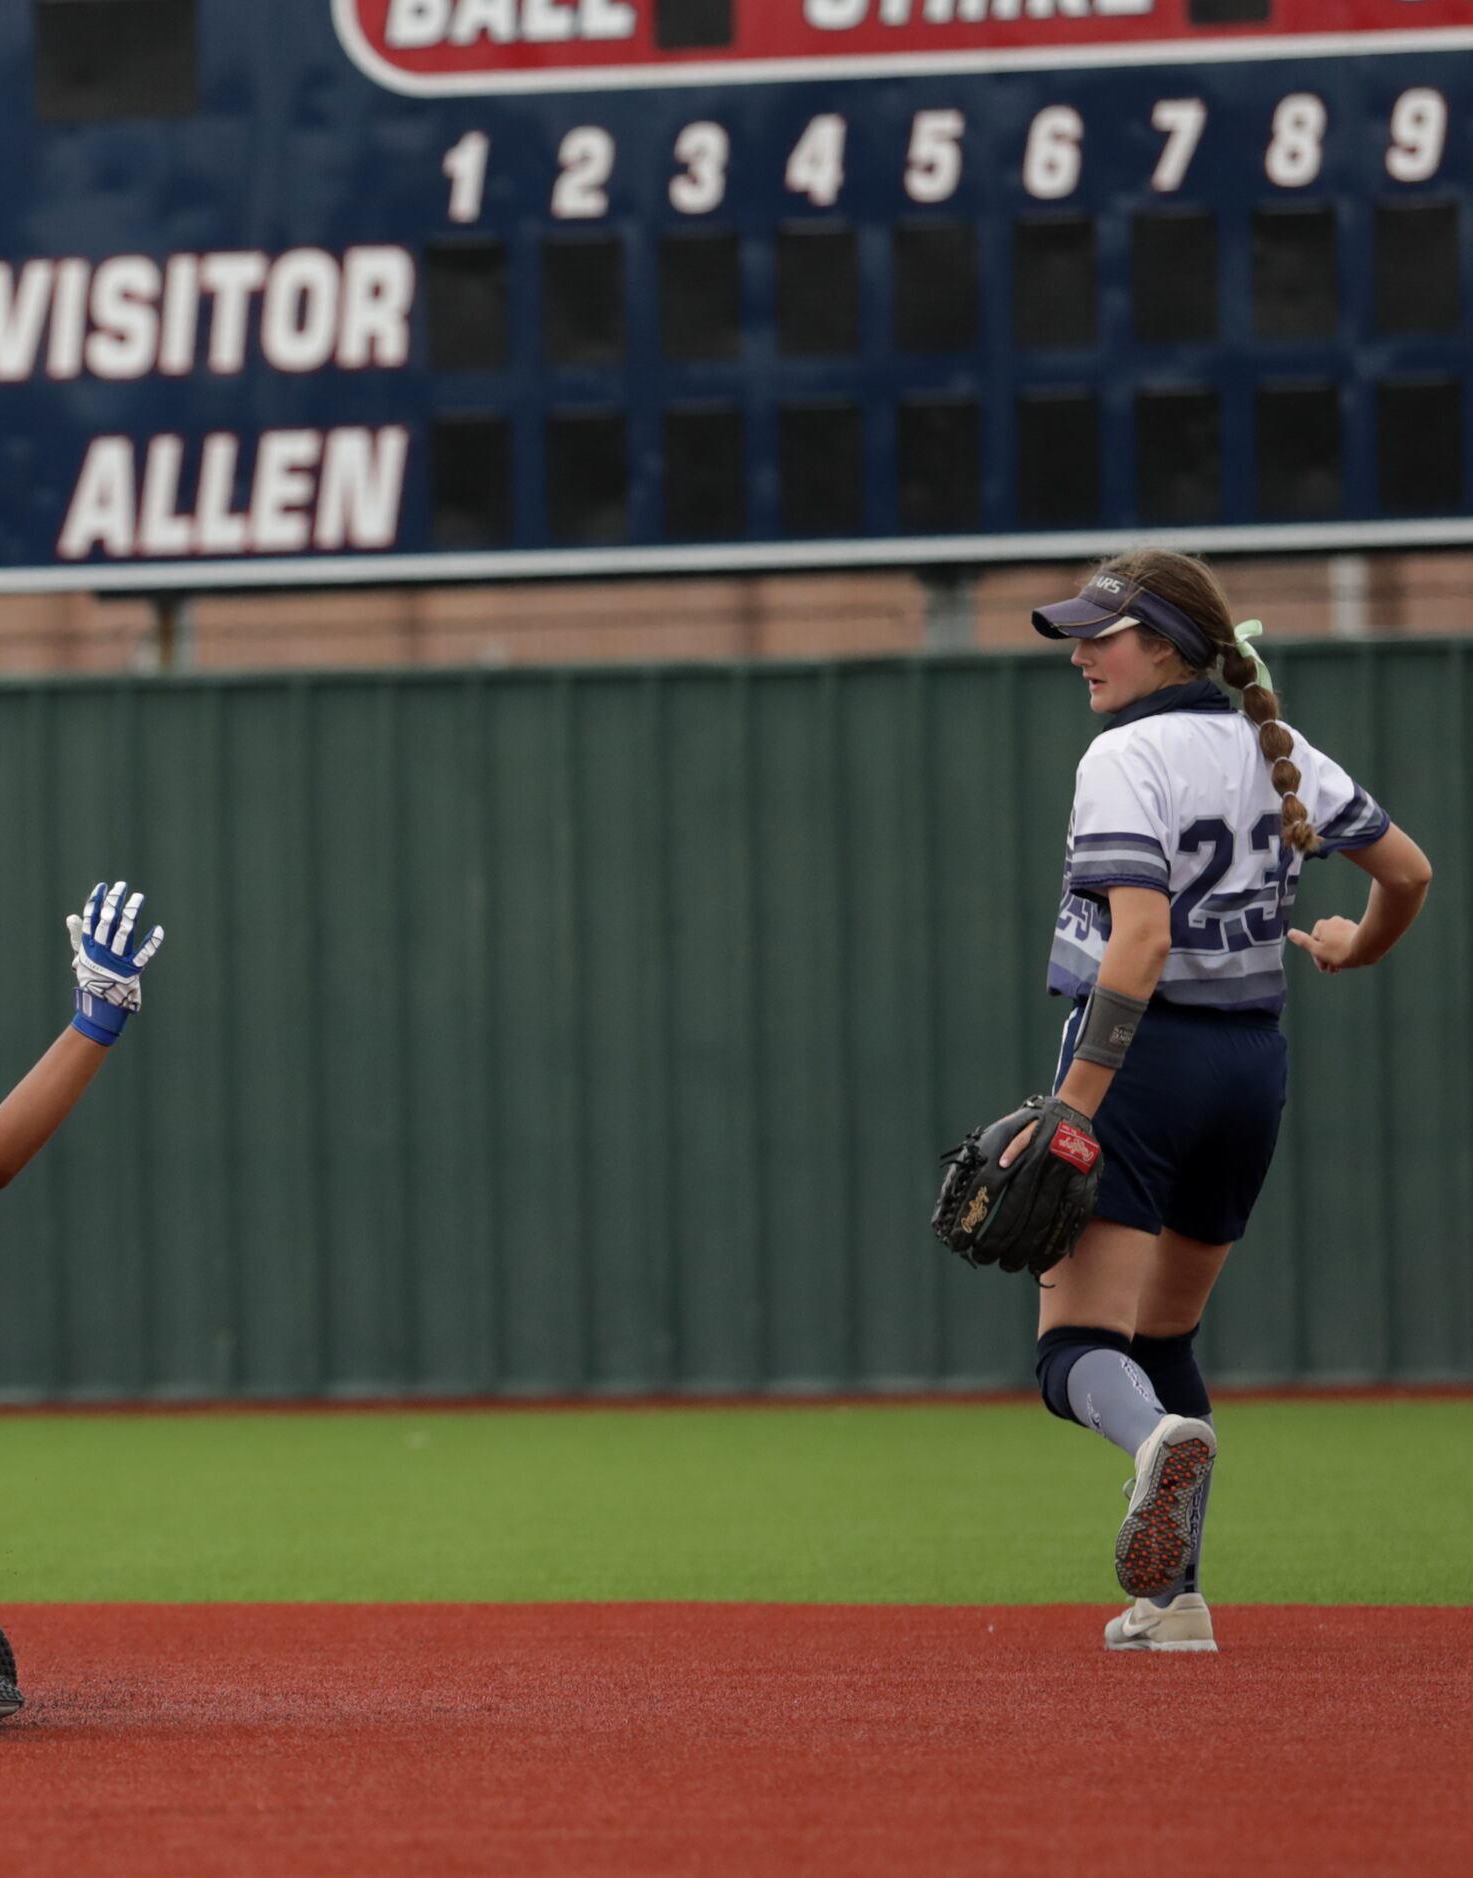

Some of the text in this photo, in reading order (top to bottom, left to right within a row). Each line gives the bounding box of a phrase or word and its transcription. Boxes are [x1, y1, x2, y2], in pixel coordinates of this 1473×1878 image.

[442, 87, 1447, 223] 1 2 3 4 5 6 7 8 9
[57, 424, 410, 560] ALLEN
[1169, 809, 1298, 952] 23
